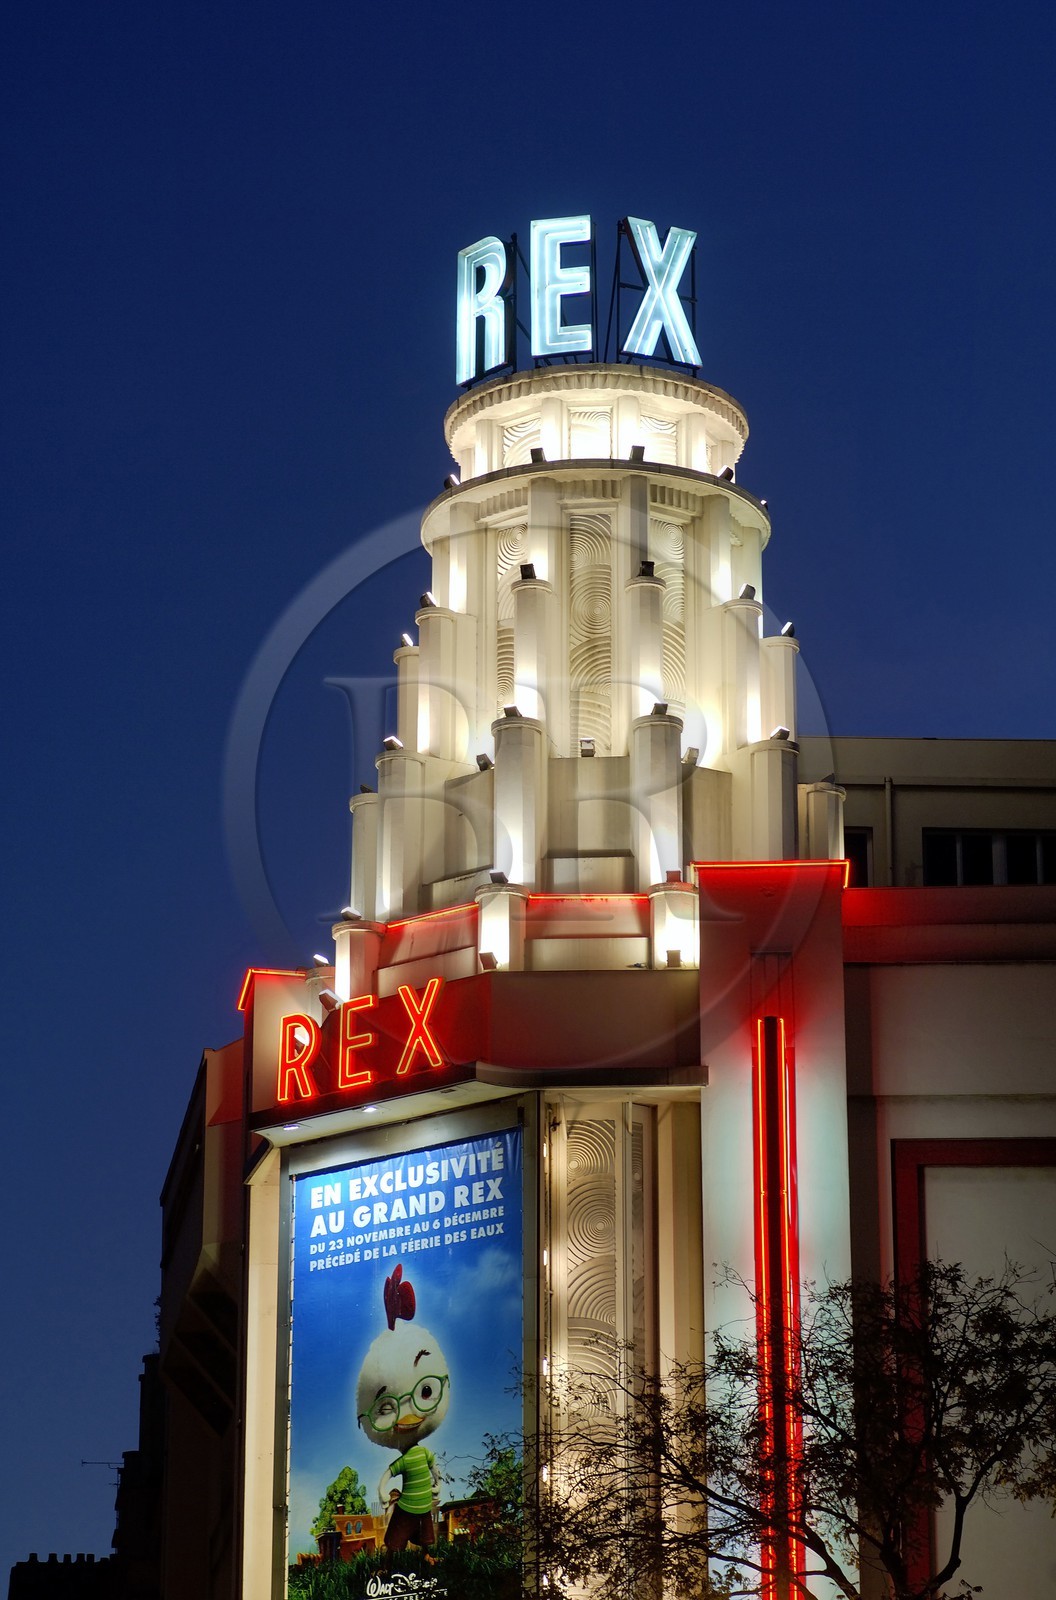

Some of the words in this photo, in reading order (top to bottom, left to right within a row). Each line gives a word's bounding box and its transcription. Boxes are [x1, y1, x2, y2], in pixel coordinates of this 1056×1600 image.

[456, 214, 703, 386] REX
[277, 977, 444, 1101] REX
[310, 1182, 342, 1209] EN
[349, 1144, 504, 1201] EXCLUSIVITÉ
[310, 1210, 345, 1238] AU
[353, 1190, 446, 1228] GRAND
[453, 1177, 504, 1209] REX
[309, 1248, 361, 1272] PRÉCÉDÉ
[363, 1247, 380, 1261] DE
[382, 1244, 398, 1257] LA
[400, 1235, 441, 1254] FÉERIE
[444, 1230, 468, 1245] DES
[470, 1222, 505, 1240] EAUX
[310, 1242, 326, 1255] DU
[328, 1238, 344, 1251] 23
[346, 1225, 411, 1248] NOVEMBRE
[413, 1221, 430, 1234] AU
[432, 1218, 441, 1230] 6
[444, 1205, 505, 1228] DÉCEMBRE
